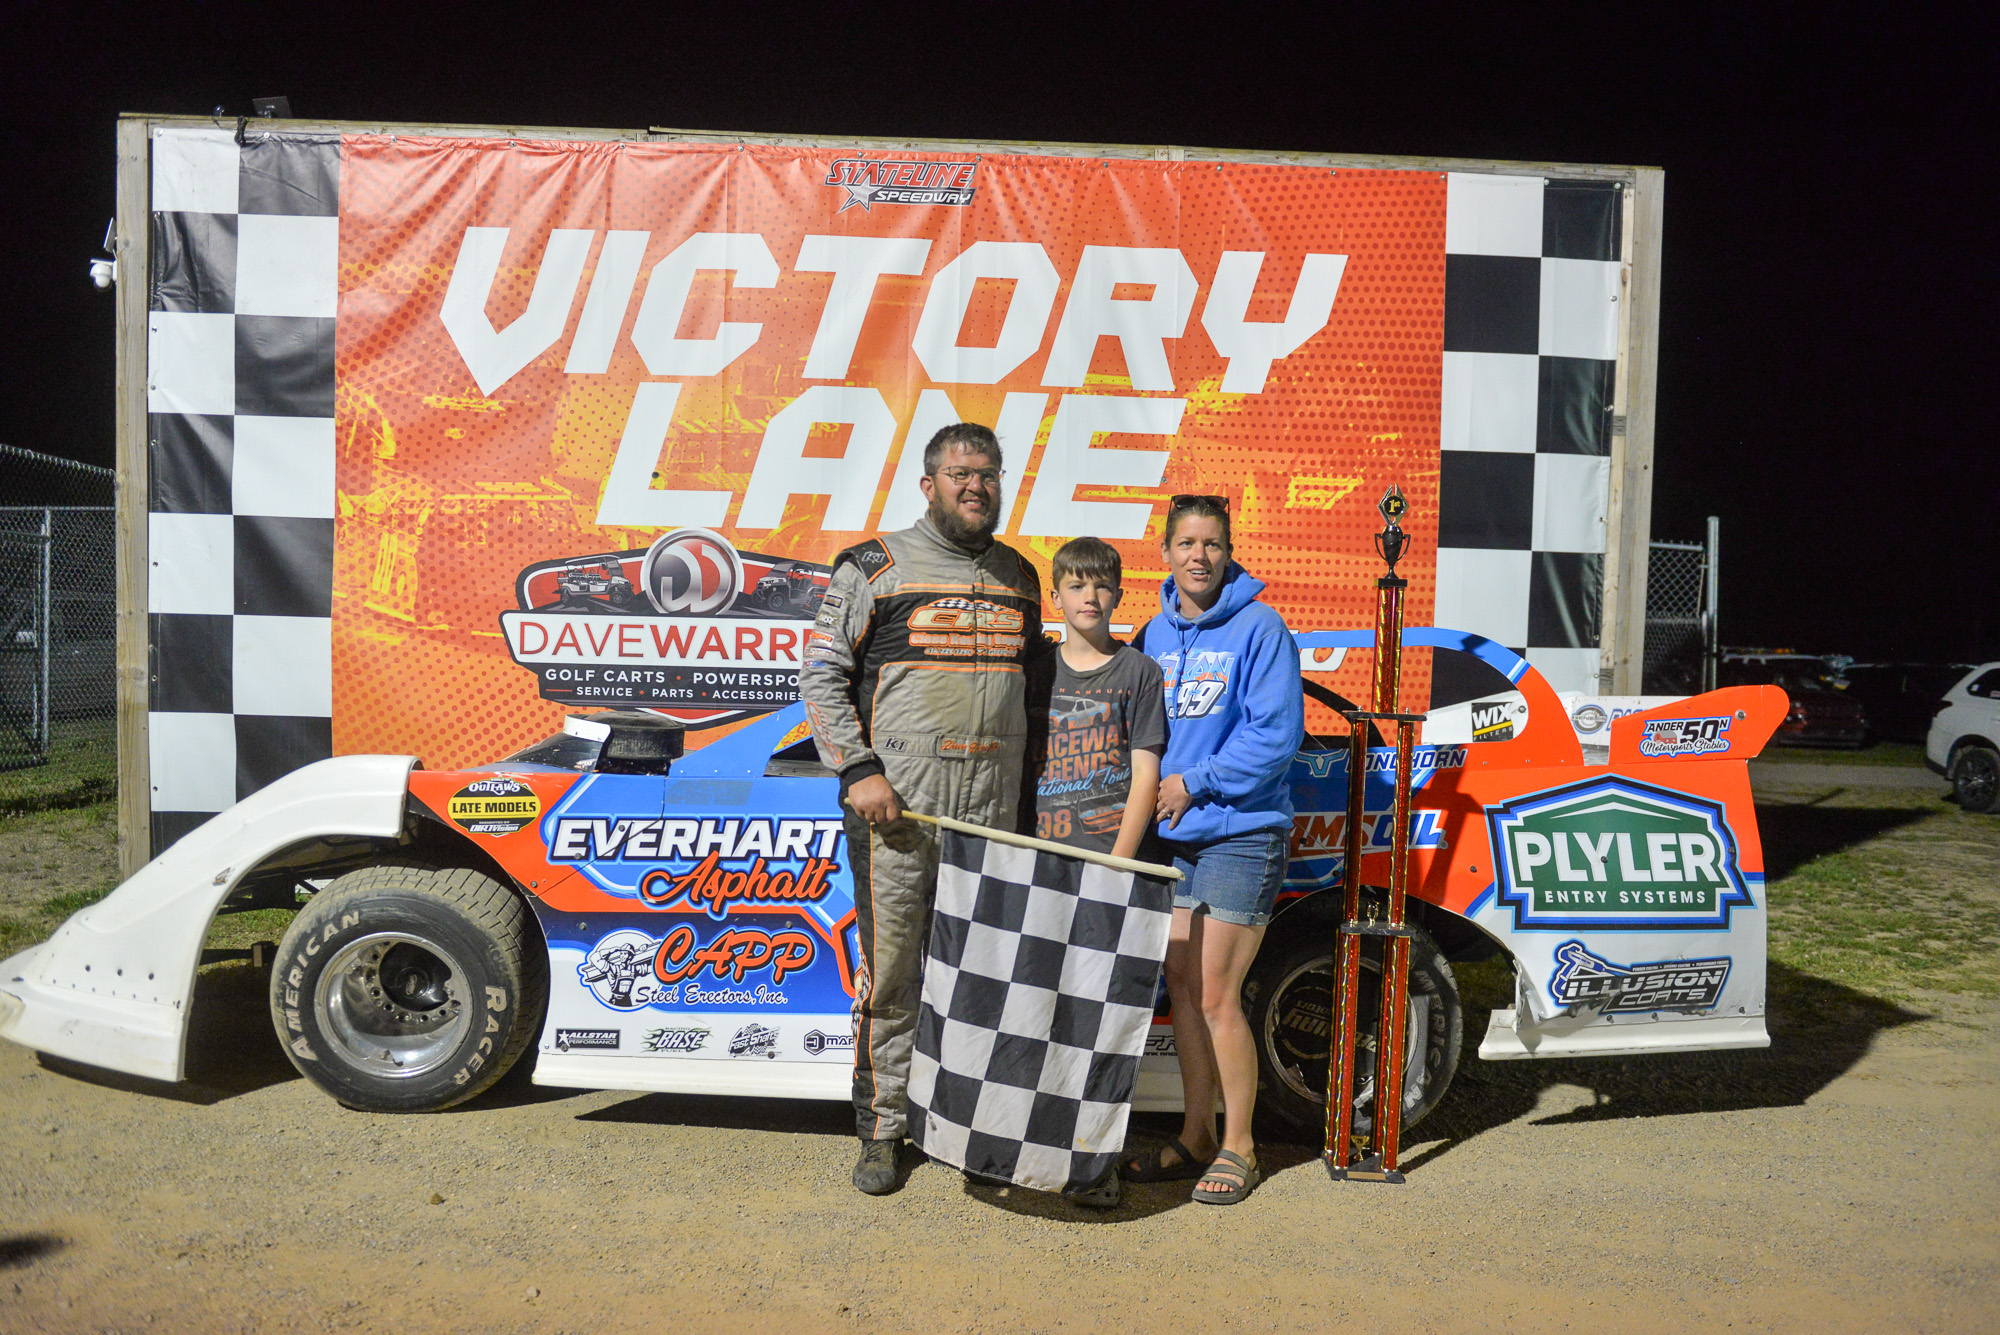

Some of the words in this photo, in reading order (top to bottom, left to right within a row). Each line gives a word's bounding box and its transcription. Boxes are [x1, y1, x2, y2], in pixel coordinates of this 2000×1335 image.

[827, 160, 975, 187] STATELINE
[875, 190, 972, 203] SPEEDWAY
[439, 226, 1349, 397] VICTORY
[594, 381, 1188, 539] LANE
[1389, 499, 1401, 512] 1st
[545, 668, 595, 681] GOLF
[603, 669, 666, 684] CARTS
[692, 672, 800, 687] POWERSPO
[576, 686, 633, 697] SERVICE
[652, 688, 694, 698] PARTS
[712, 689, 804, 701] ACCESSORIES
[1168, 680, 1226, 718] 99
[1472, 703, 1512, 729] WIX
[1473, 726, 1514, 742] FILTERS
[1642, 740, 1693, 755] Motorsports
[1694, 739, 1727, 752] Stables
[1041, 749, 1121, 785] GENDS
[1345, 749, 1467, 772] ONORN
[452, 802, 481, 813] LATE
[485, 801, 536, 813] MODELS
[552, 818, 845, 858] EVERHART
[1514, 831, 1721, 882] PLYLER
[641, 850, 838, 913] Asphalt
[1545, 890, 1607, 904] ENTRY
[1619, 890, 1706, 904] SYSTEMS
[654, 926, 815, 985] CAPP
[285, 911, 360, 1062] AMERICAN
[635, 985, 679, 1003] Steel
[756, 983, 788, 1004] Inc.
[1566, 970, 1723, 997] ILLUSION
[1619, 987, 1708, 1006] COATS
[454, 986, 508, 1085] RACER
[658, 1031, 709, 1049] BASE
[1402, 969, 1447, 1107] MERICAN
